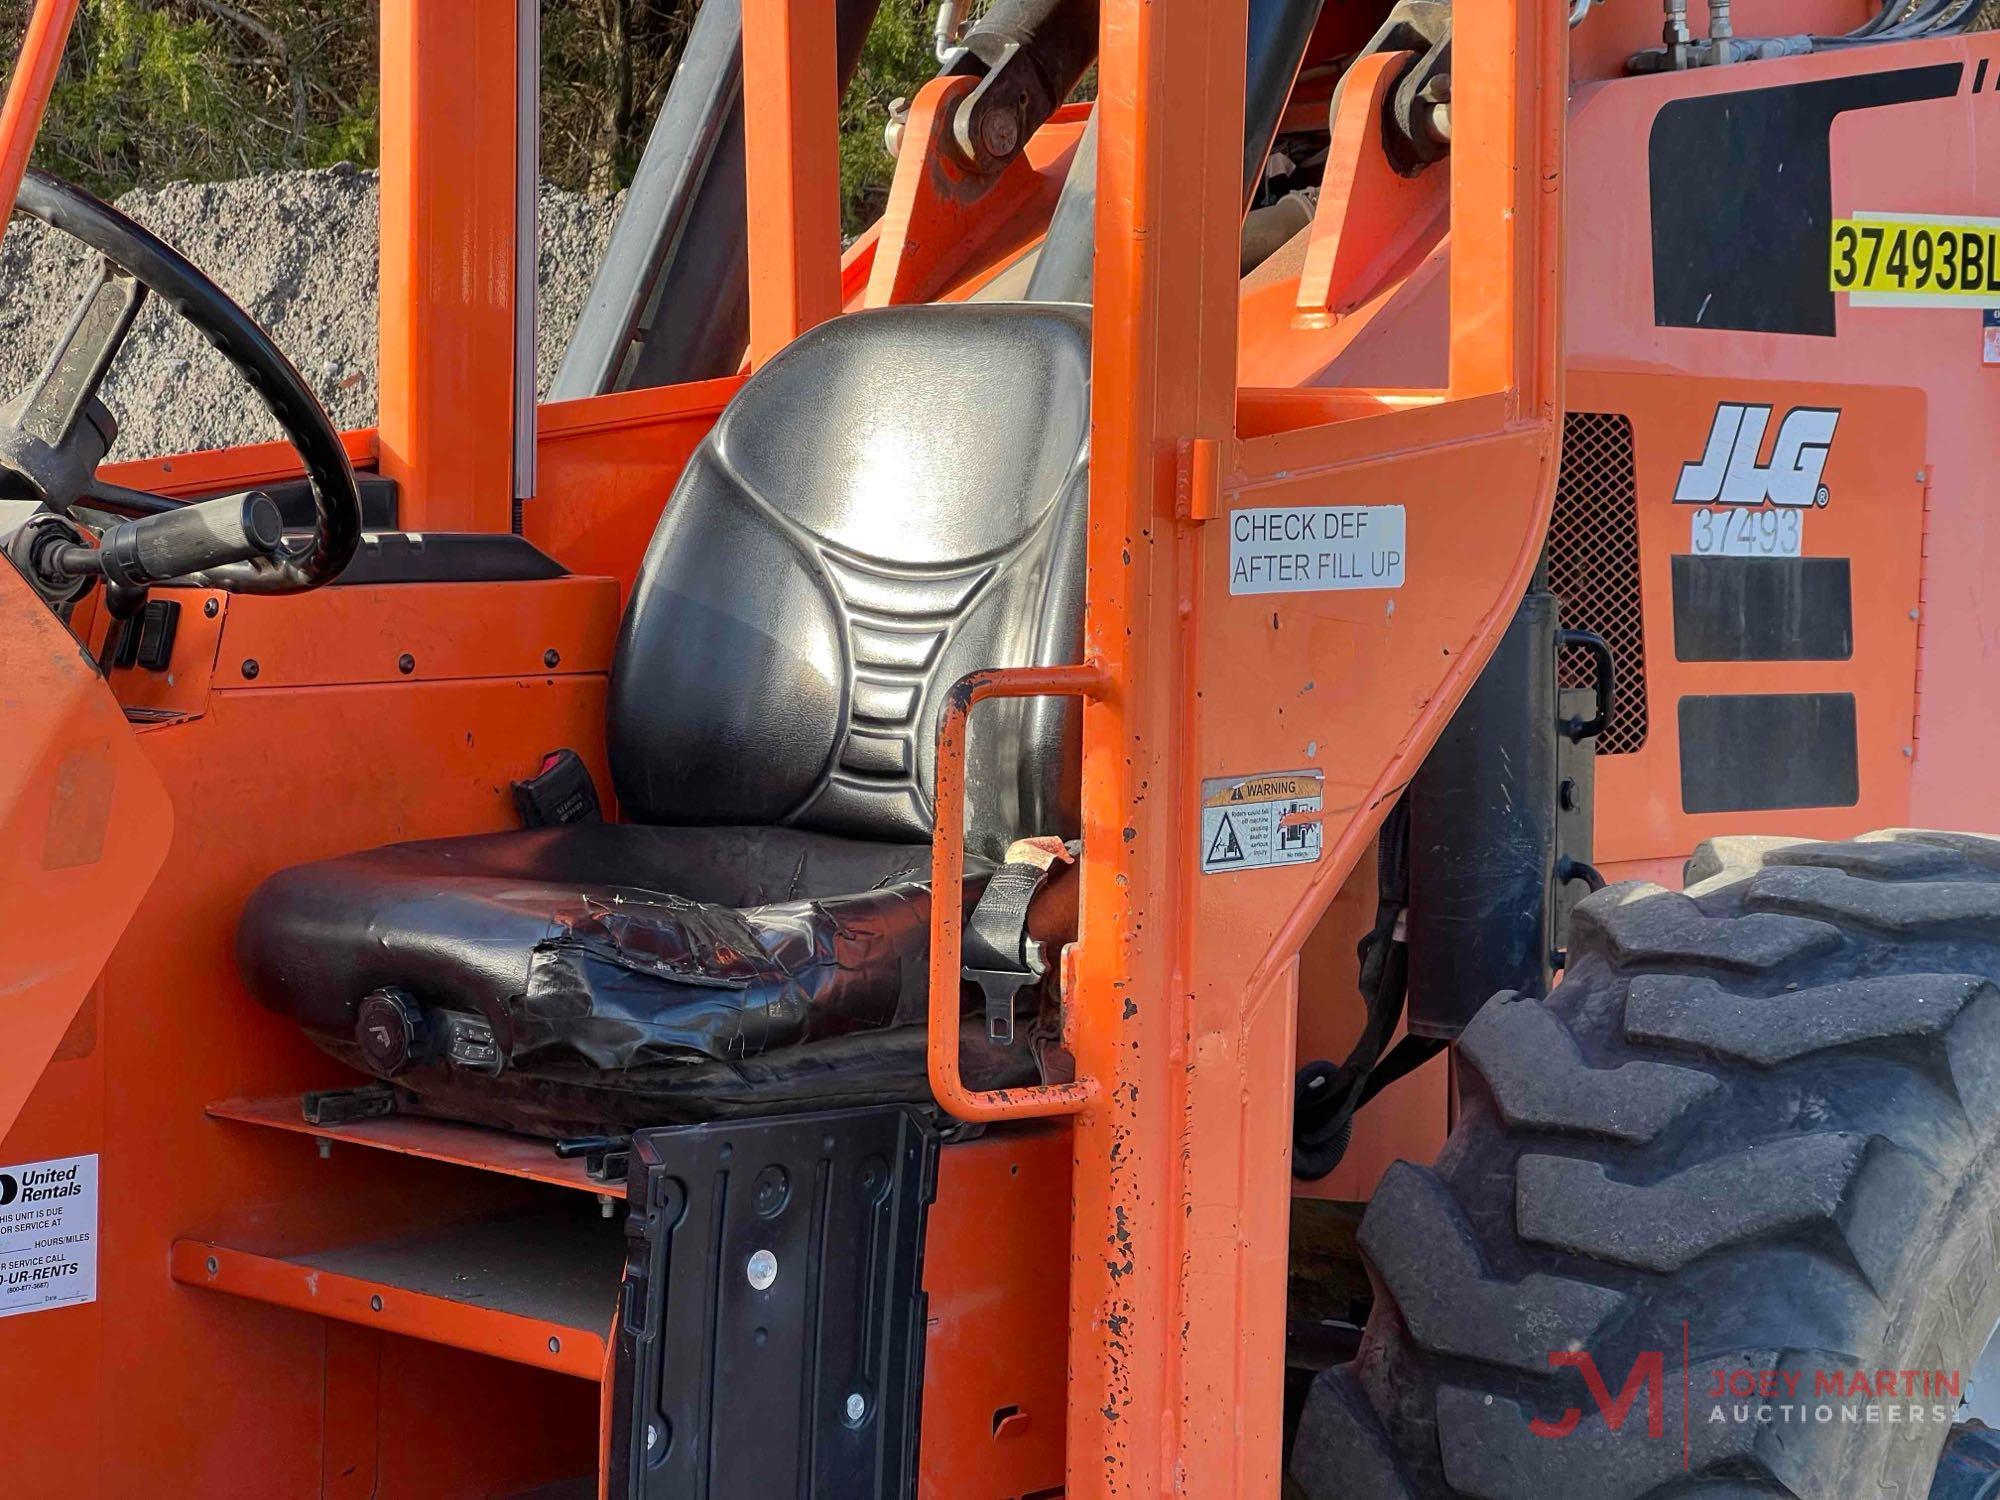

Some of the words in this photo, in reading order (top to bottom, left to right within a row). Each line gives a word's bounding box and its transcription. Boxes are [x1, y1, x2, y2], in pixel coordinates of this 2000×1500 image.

[1833, 225, 2000, 291] 37493BL
[1672, 400, 1842, 509] JLG
[1234, 513, 1316, 542] CHECK
[1323, 512, 1368, 539] DEF
[1695, 508, 1799, 553] 37493
[1233, 554, 1310, 583] AFTER
[1318, 552, 1363, 579] FILL
[1371, 550, 1400, 577] UP
[1247, 781, 1296, 797] WARNING
[22, 1165, 78, 1187] United
[21, 1182, 81, 1203] Rentals
[15, 1211, 34, 1221] UNIT
[36, 1209, 45, 1219] IS
[46, 1206, 63, 1217] DUE
[14, 1219, 50, 1233] SERVICE
[51, 1217, 62, 1227] AT
[34, 1233, 90, 1249] HOURS/MILES
[8, 1256, 44, 1270] SERVICE
[45, 1253, 66, 1264] CALL
